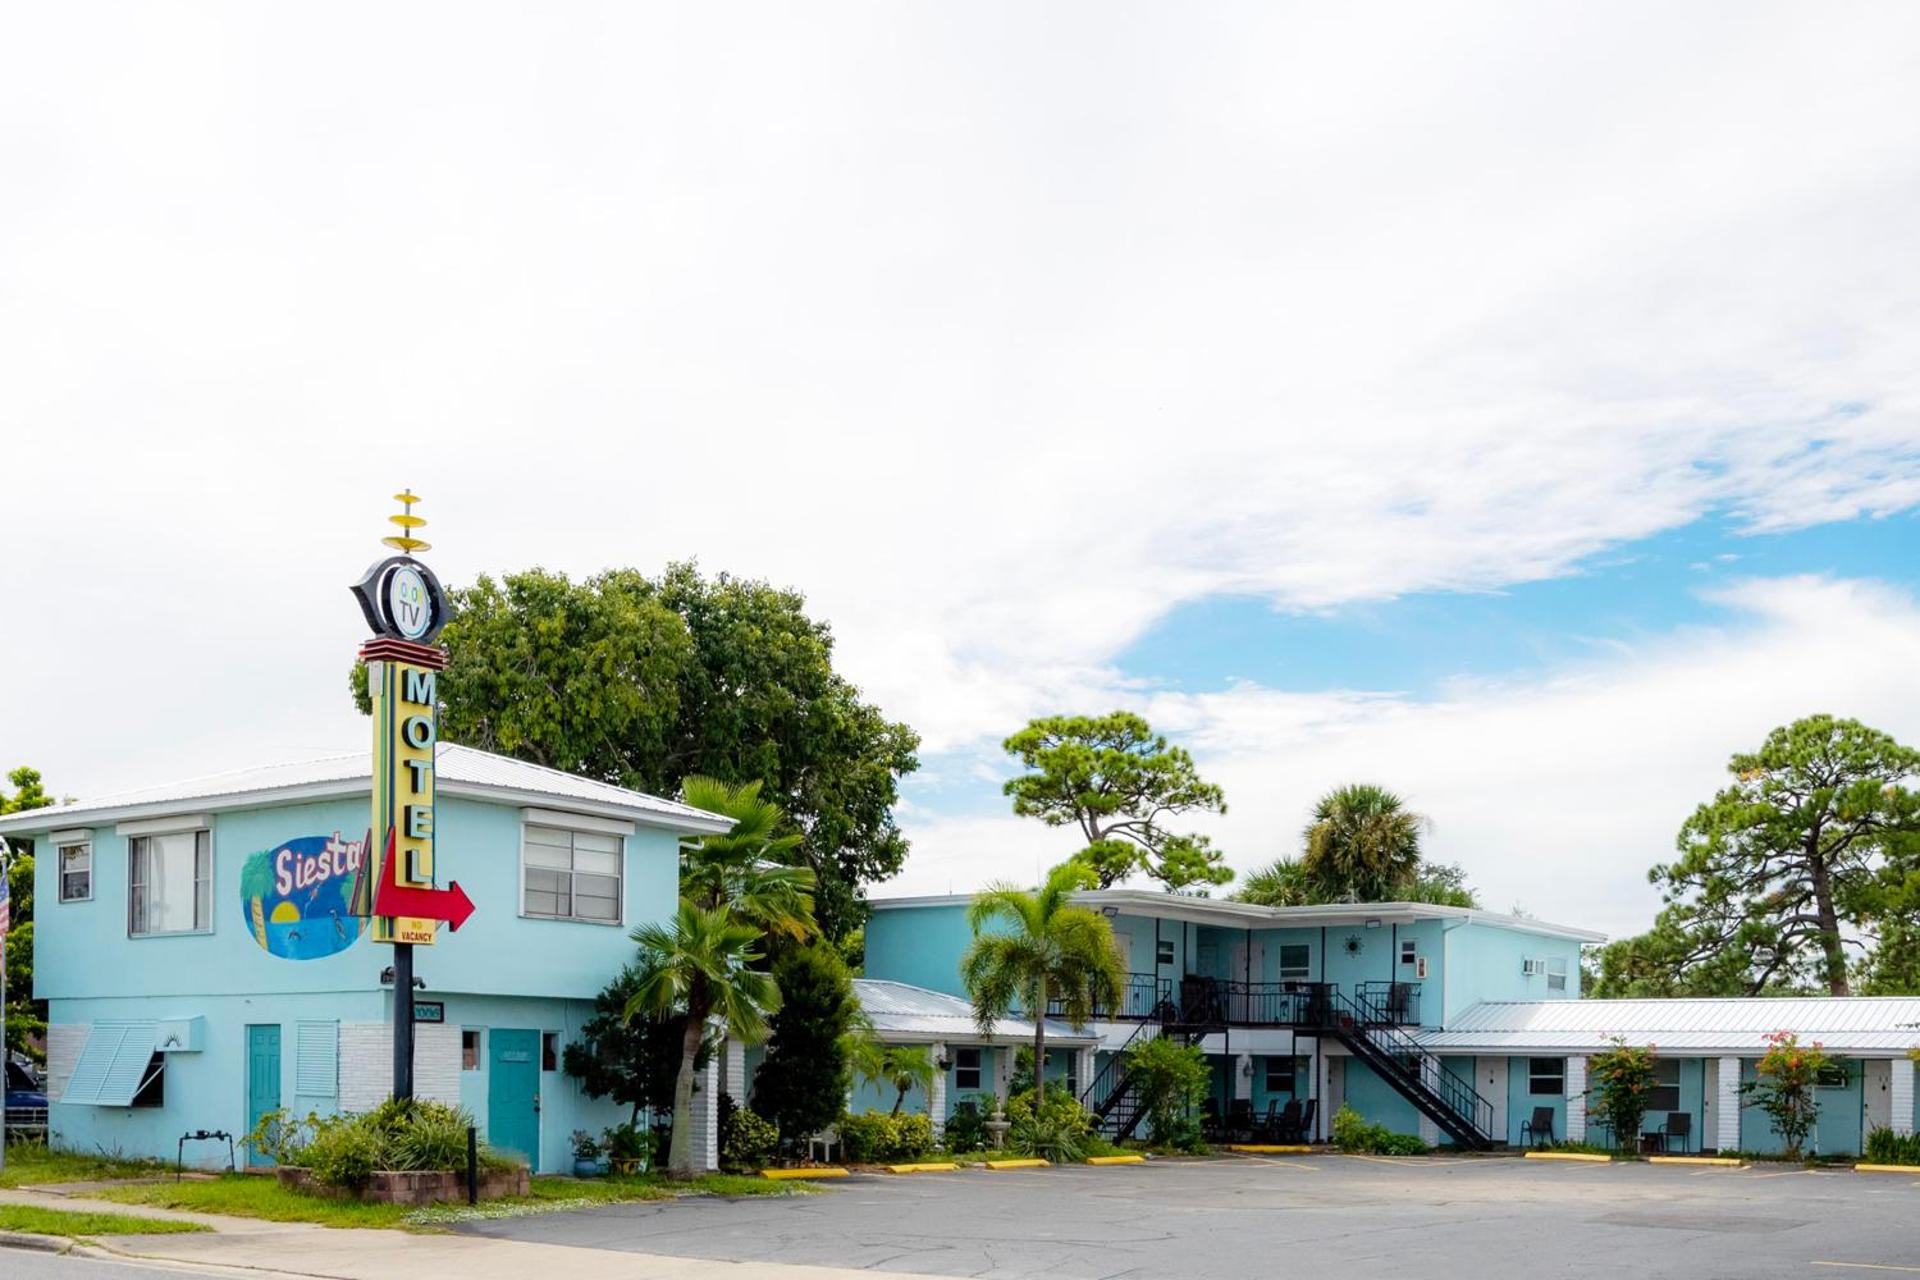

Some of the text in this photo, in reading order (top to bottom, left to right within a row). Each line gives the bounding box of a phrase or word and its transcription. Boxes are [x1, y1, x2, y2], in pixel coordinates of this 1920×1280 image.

[399, 599, 421, 627] TV
[402, 668, 436, 885] MOTEL
[275, 830, 362, 897] Siesta
[401, 931, 432, 942] VACANCY
[411, 920, 423, 930] NO
